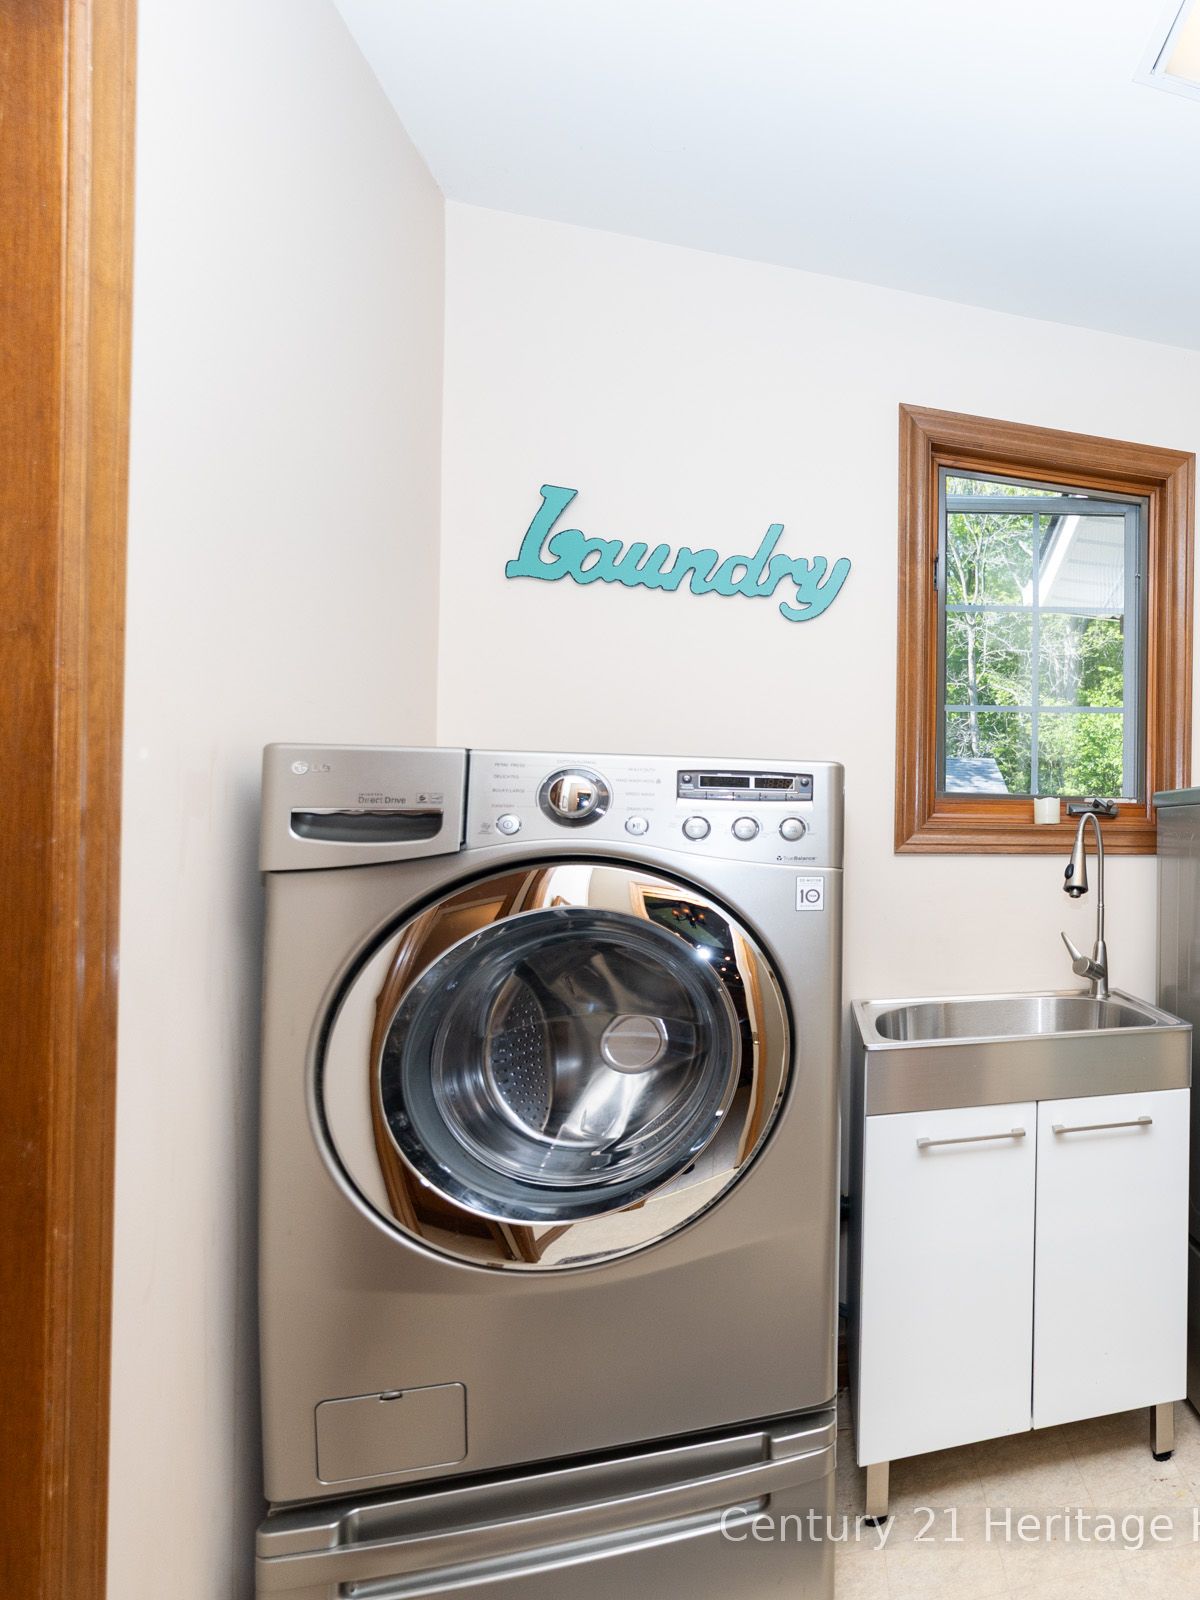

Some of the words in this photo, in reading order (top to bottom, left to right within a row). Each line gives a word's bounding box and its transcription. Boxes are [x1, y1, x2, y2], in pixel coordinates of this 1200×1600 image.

[505, 484, 852, 622] Laundry
[358, 796, 383, 804] Direct
[384, 796, 406, 804] Drive
[800, 888, 820, 903] 10
